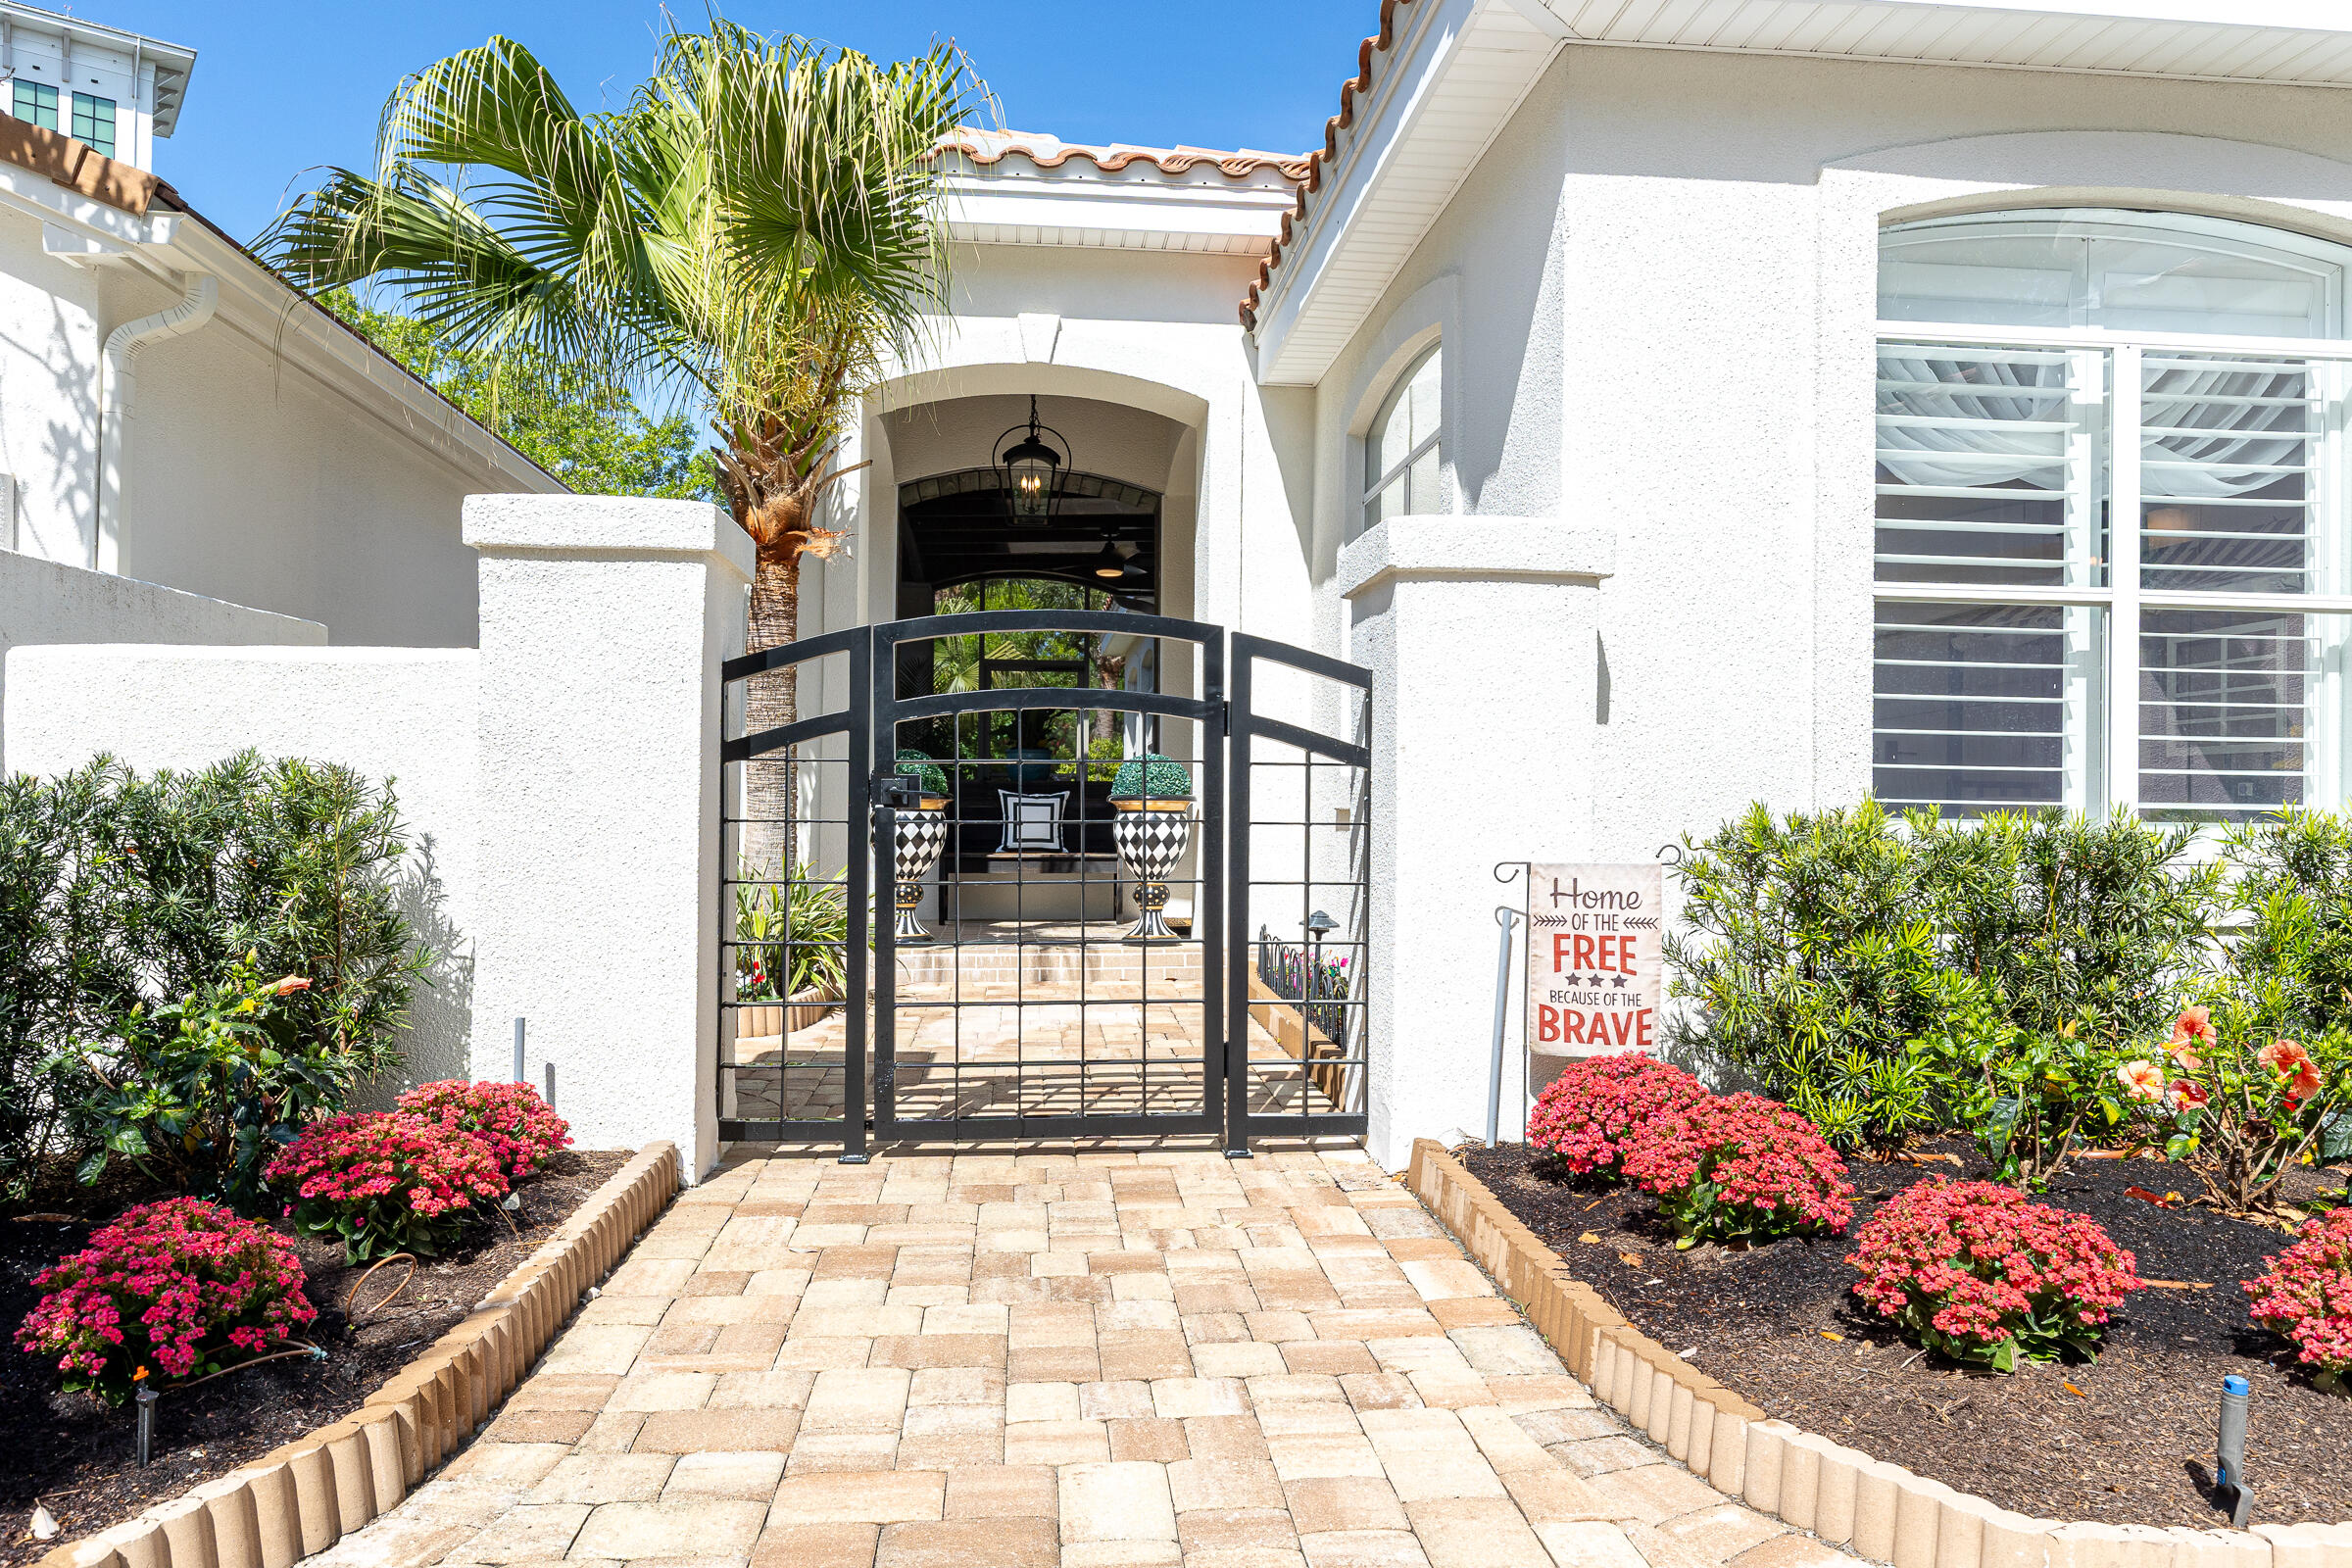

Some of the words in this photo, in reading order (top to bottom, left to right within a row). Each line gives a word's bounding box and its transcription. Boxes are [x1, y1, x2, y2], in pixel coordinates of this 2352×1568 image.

[1549, 877, 1642, 909] Home
[1572, 913, 1590, 930] OF
[1593, 913, 1619, 931] THE
[1553, 933, 1637, 976] FREE
[1549, 990, 1599, 1004] BECAUSE
[1603, 993, 1618, 1005] OF
[1621, 993, 1642, 1006] THE
[1539, 1004, 1652, 1046] BRAVE
